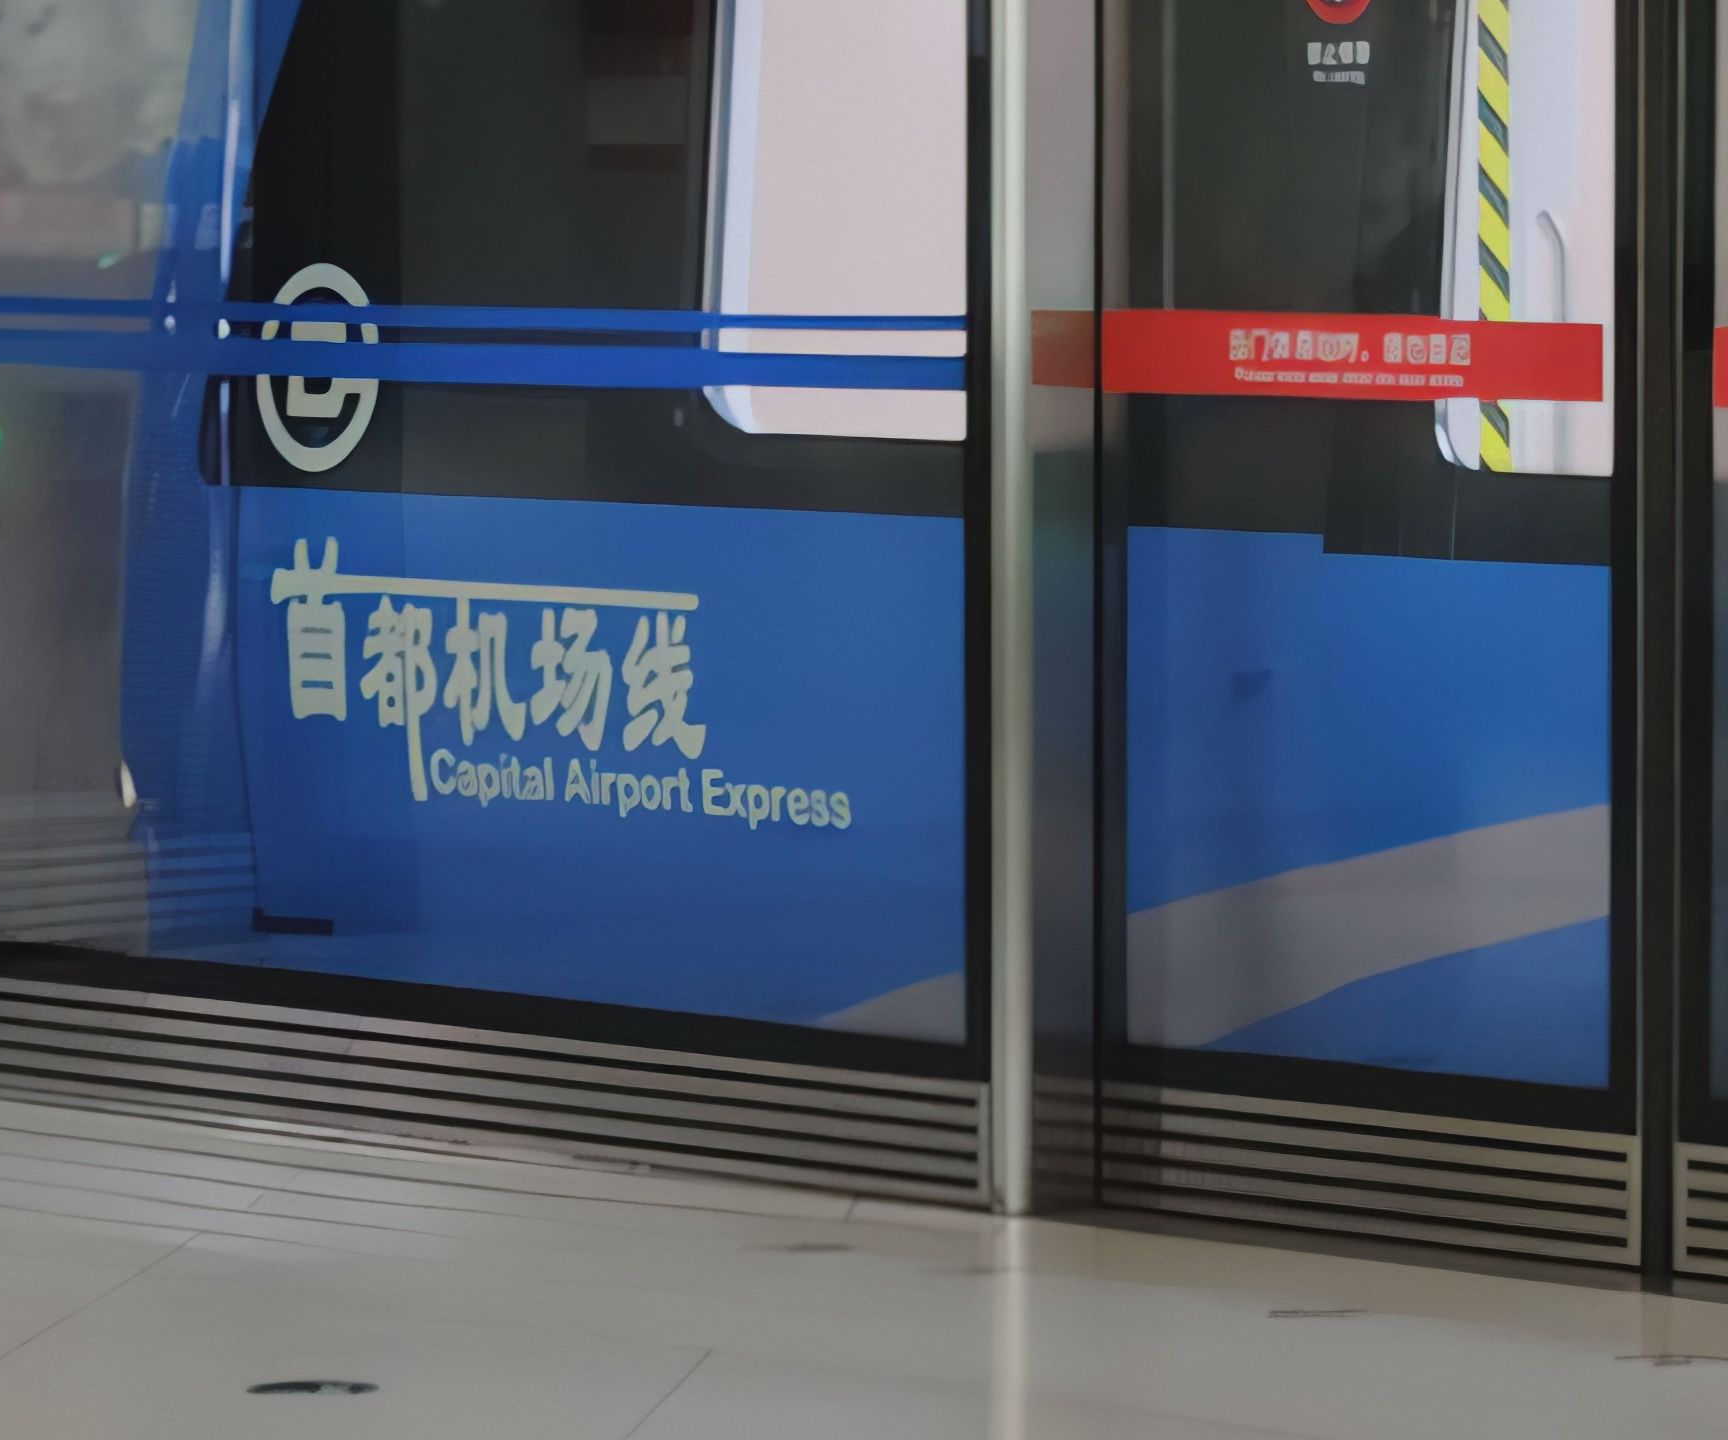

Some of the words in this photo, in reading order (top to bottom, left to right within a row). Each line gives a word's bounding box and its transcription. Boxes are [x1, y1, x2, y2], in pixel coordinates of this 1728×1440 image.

[271, 535, 706, 801] 首都机场线
[428, 746, 555, 808] Capital
[563, 756, 694, 818] Airport
[700, 767, 853, 830] Express
